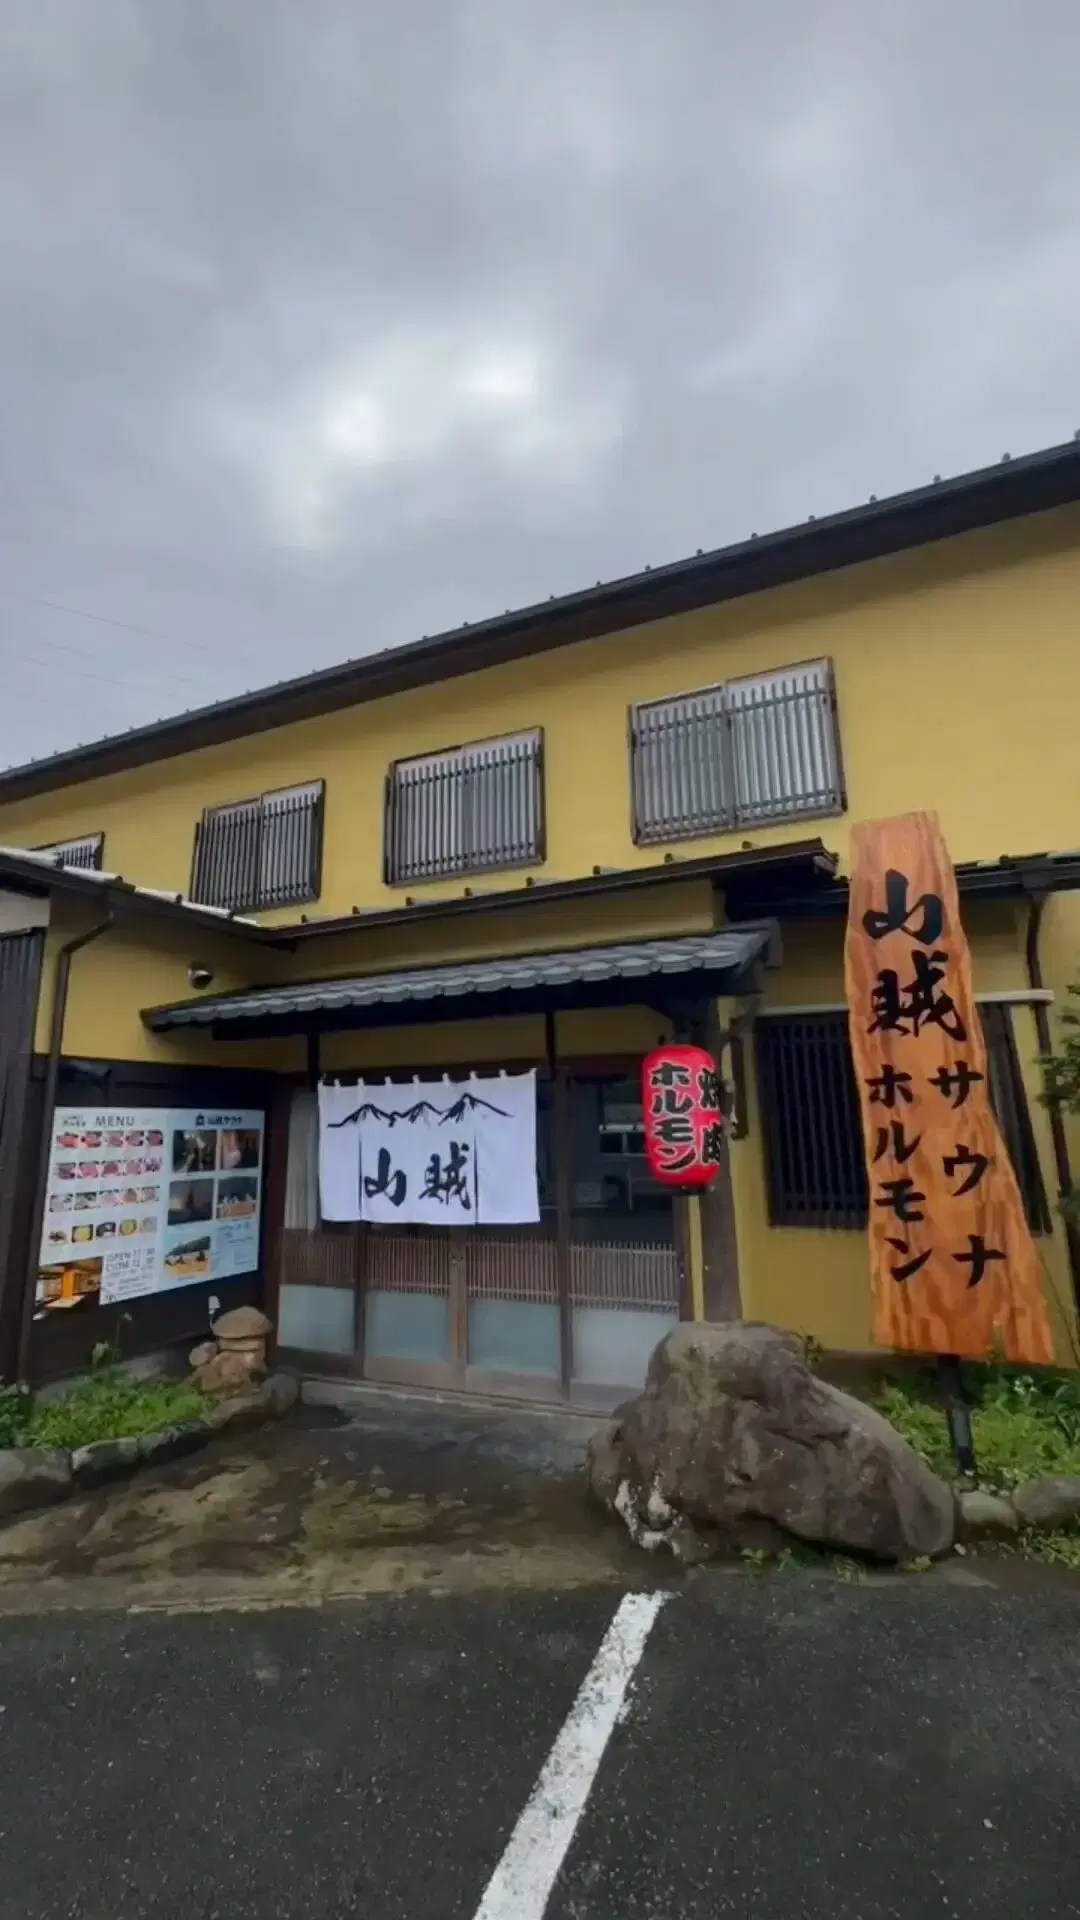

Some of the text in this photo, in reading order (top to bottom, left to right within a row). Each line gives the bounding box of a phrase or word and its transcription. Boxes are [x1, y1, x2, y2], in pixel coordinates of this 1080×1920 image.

[862, 868, 967, 1043] 山賊
[95, 1115, 136, 1128] MENU
[363, 1140, 472, 1210] 山賊
[649, 1060, 697, 1172] ホルモン
[864, 1063, 933, 1283] ホルモン
[928, 1060, 1006, 1289] サウナ
